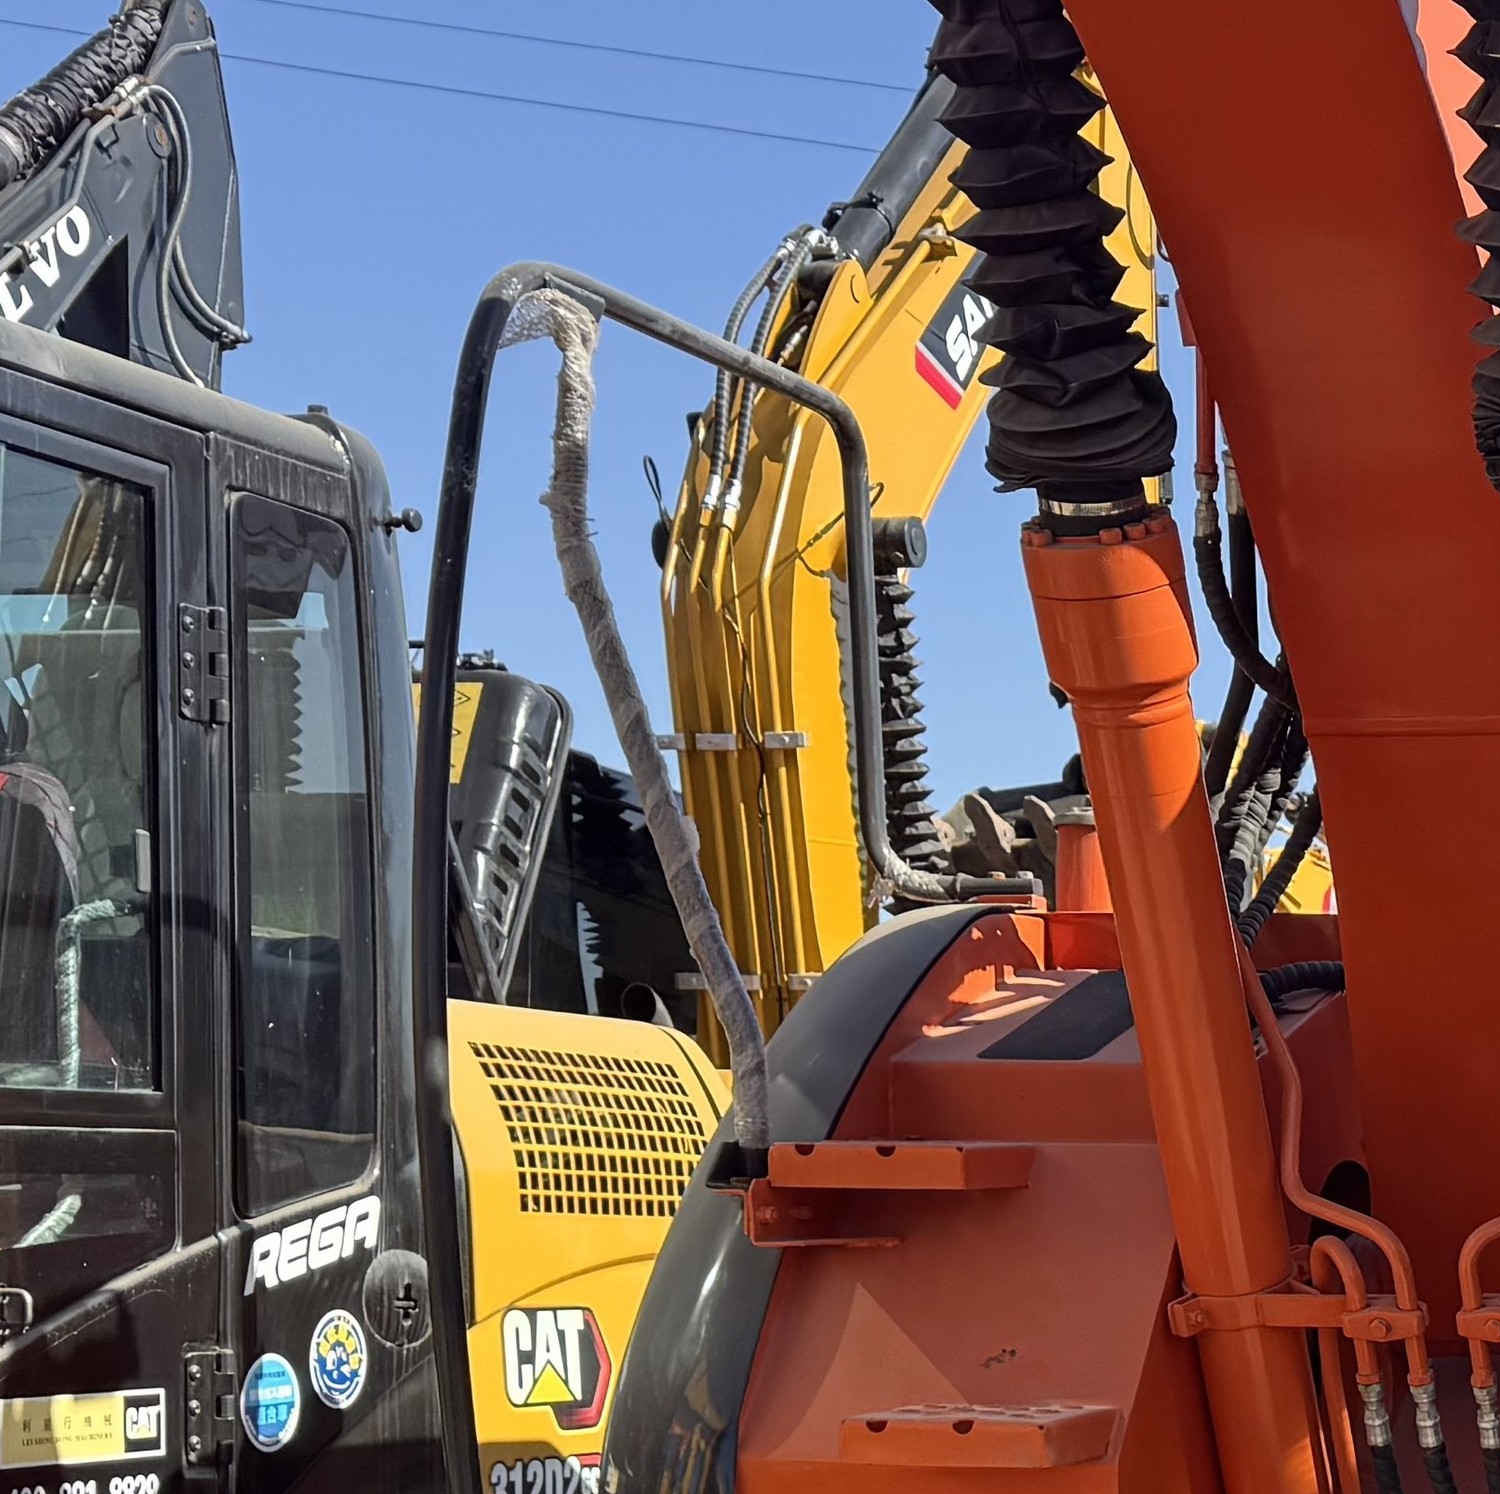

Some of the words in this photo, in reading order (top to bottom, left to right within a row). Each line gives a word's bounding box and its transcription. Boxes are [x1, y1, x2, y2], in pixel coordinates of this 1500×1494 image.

[244, 1195, 381, 1296] REGA
[503, 1309, 584, 1406] CAT
[125, 1404, 161, 1440] CAT
